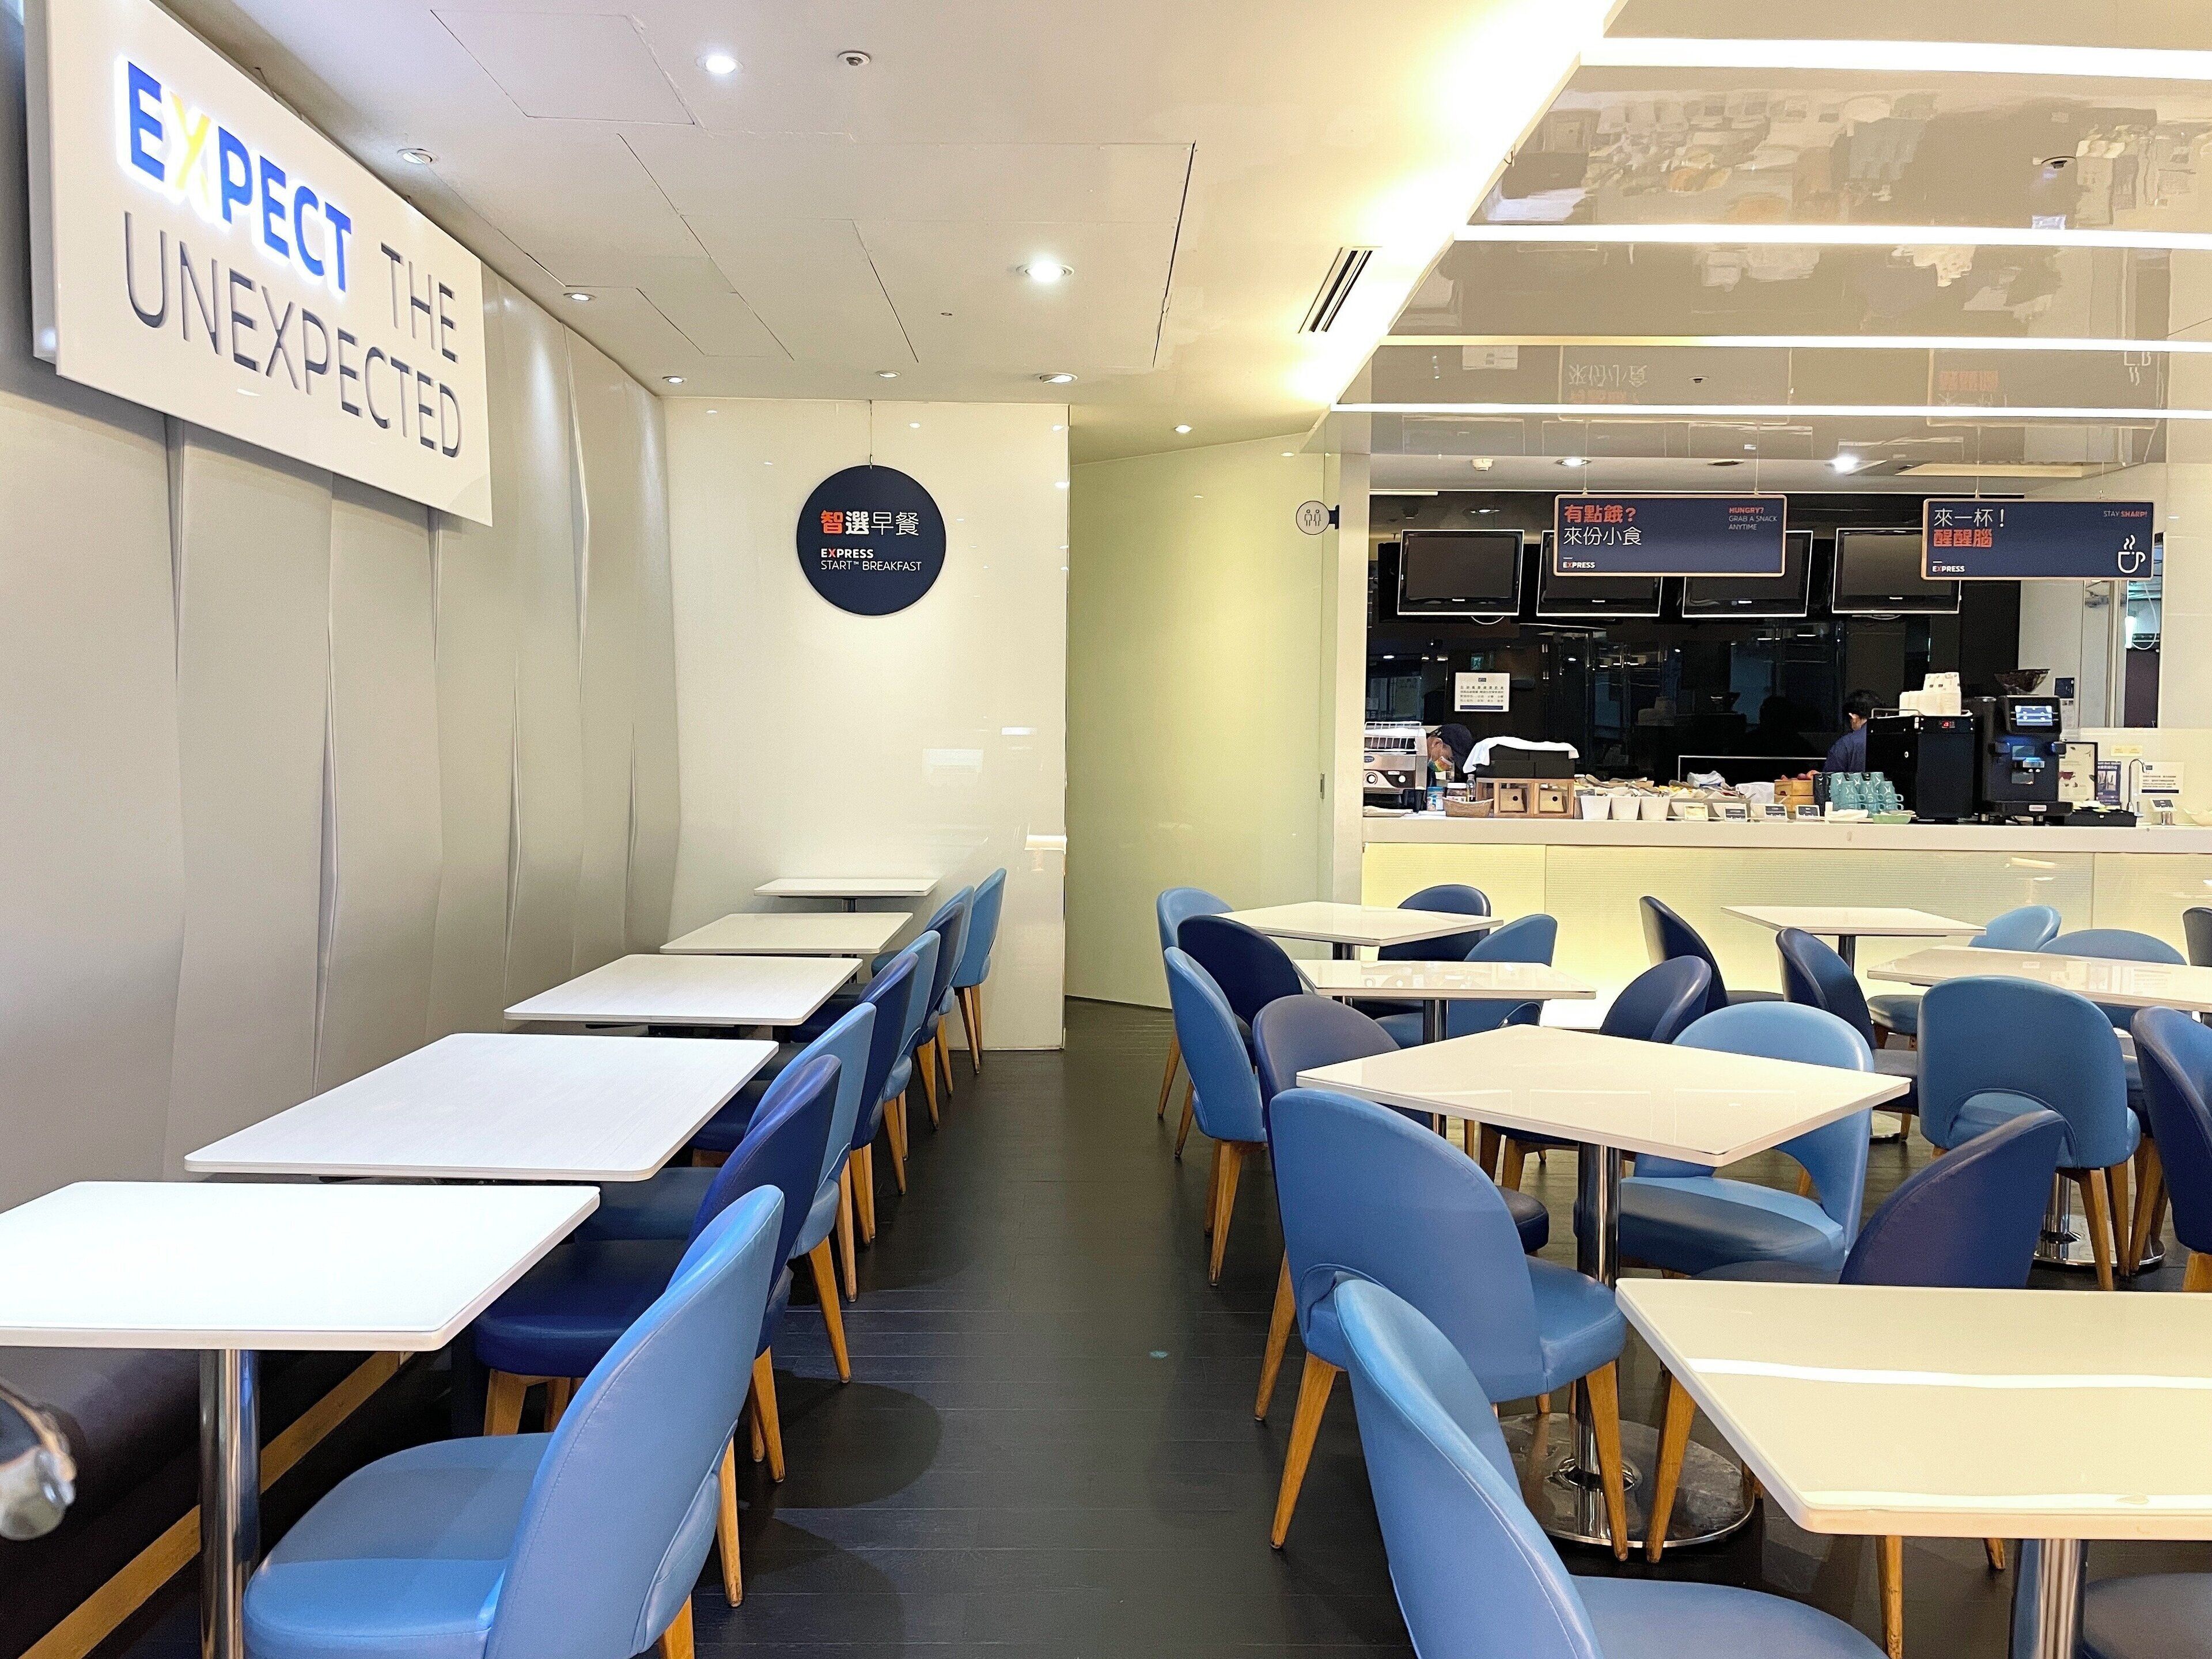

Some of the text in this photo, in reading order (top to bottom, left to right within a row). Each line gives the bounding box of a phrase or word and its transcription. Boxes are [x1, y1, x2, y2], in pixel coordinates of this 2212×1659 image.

[127, 60, 459, 363] EXPECT THE
[124, 211, 463, 459] UNEXPECTED
[820, 510, 919, 536] 智選早餐
[1563, 526, 1642, 546] 來份小食
[1934, 528, 1993, 547] 醒醒腦
[821, 548, 874, 558] EXPRESS
[862, 561, 922, 571] BREAKFAST
